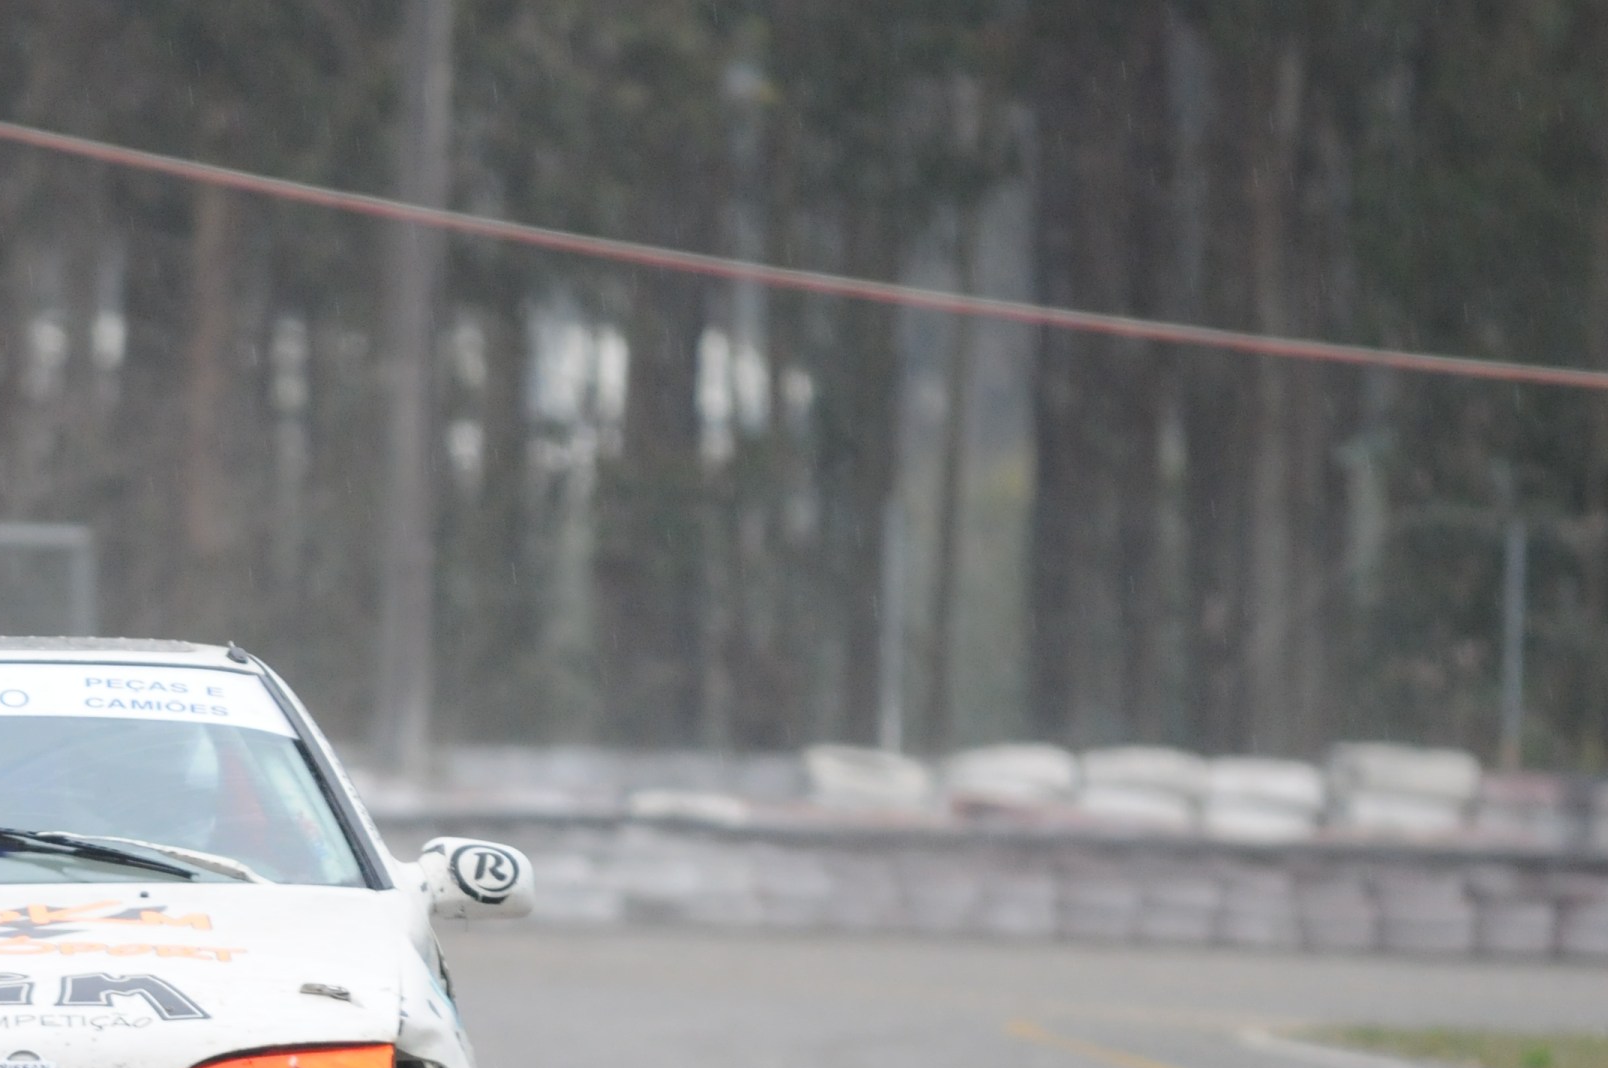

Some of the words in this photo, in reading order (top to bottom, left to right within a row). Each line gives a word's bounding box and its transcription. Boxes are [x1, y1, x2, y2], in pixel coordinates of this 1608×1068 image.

[84, 677, 189, 693] PEÇAS
[206, 686, 226, 698] E
[84, 697, 230, 717] CAMIÕES
